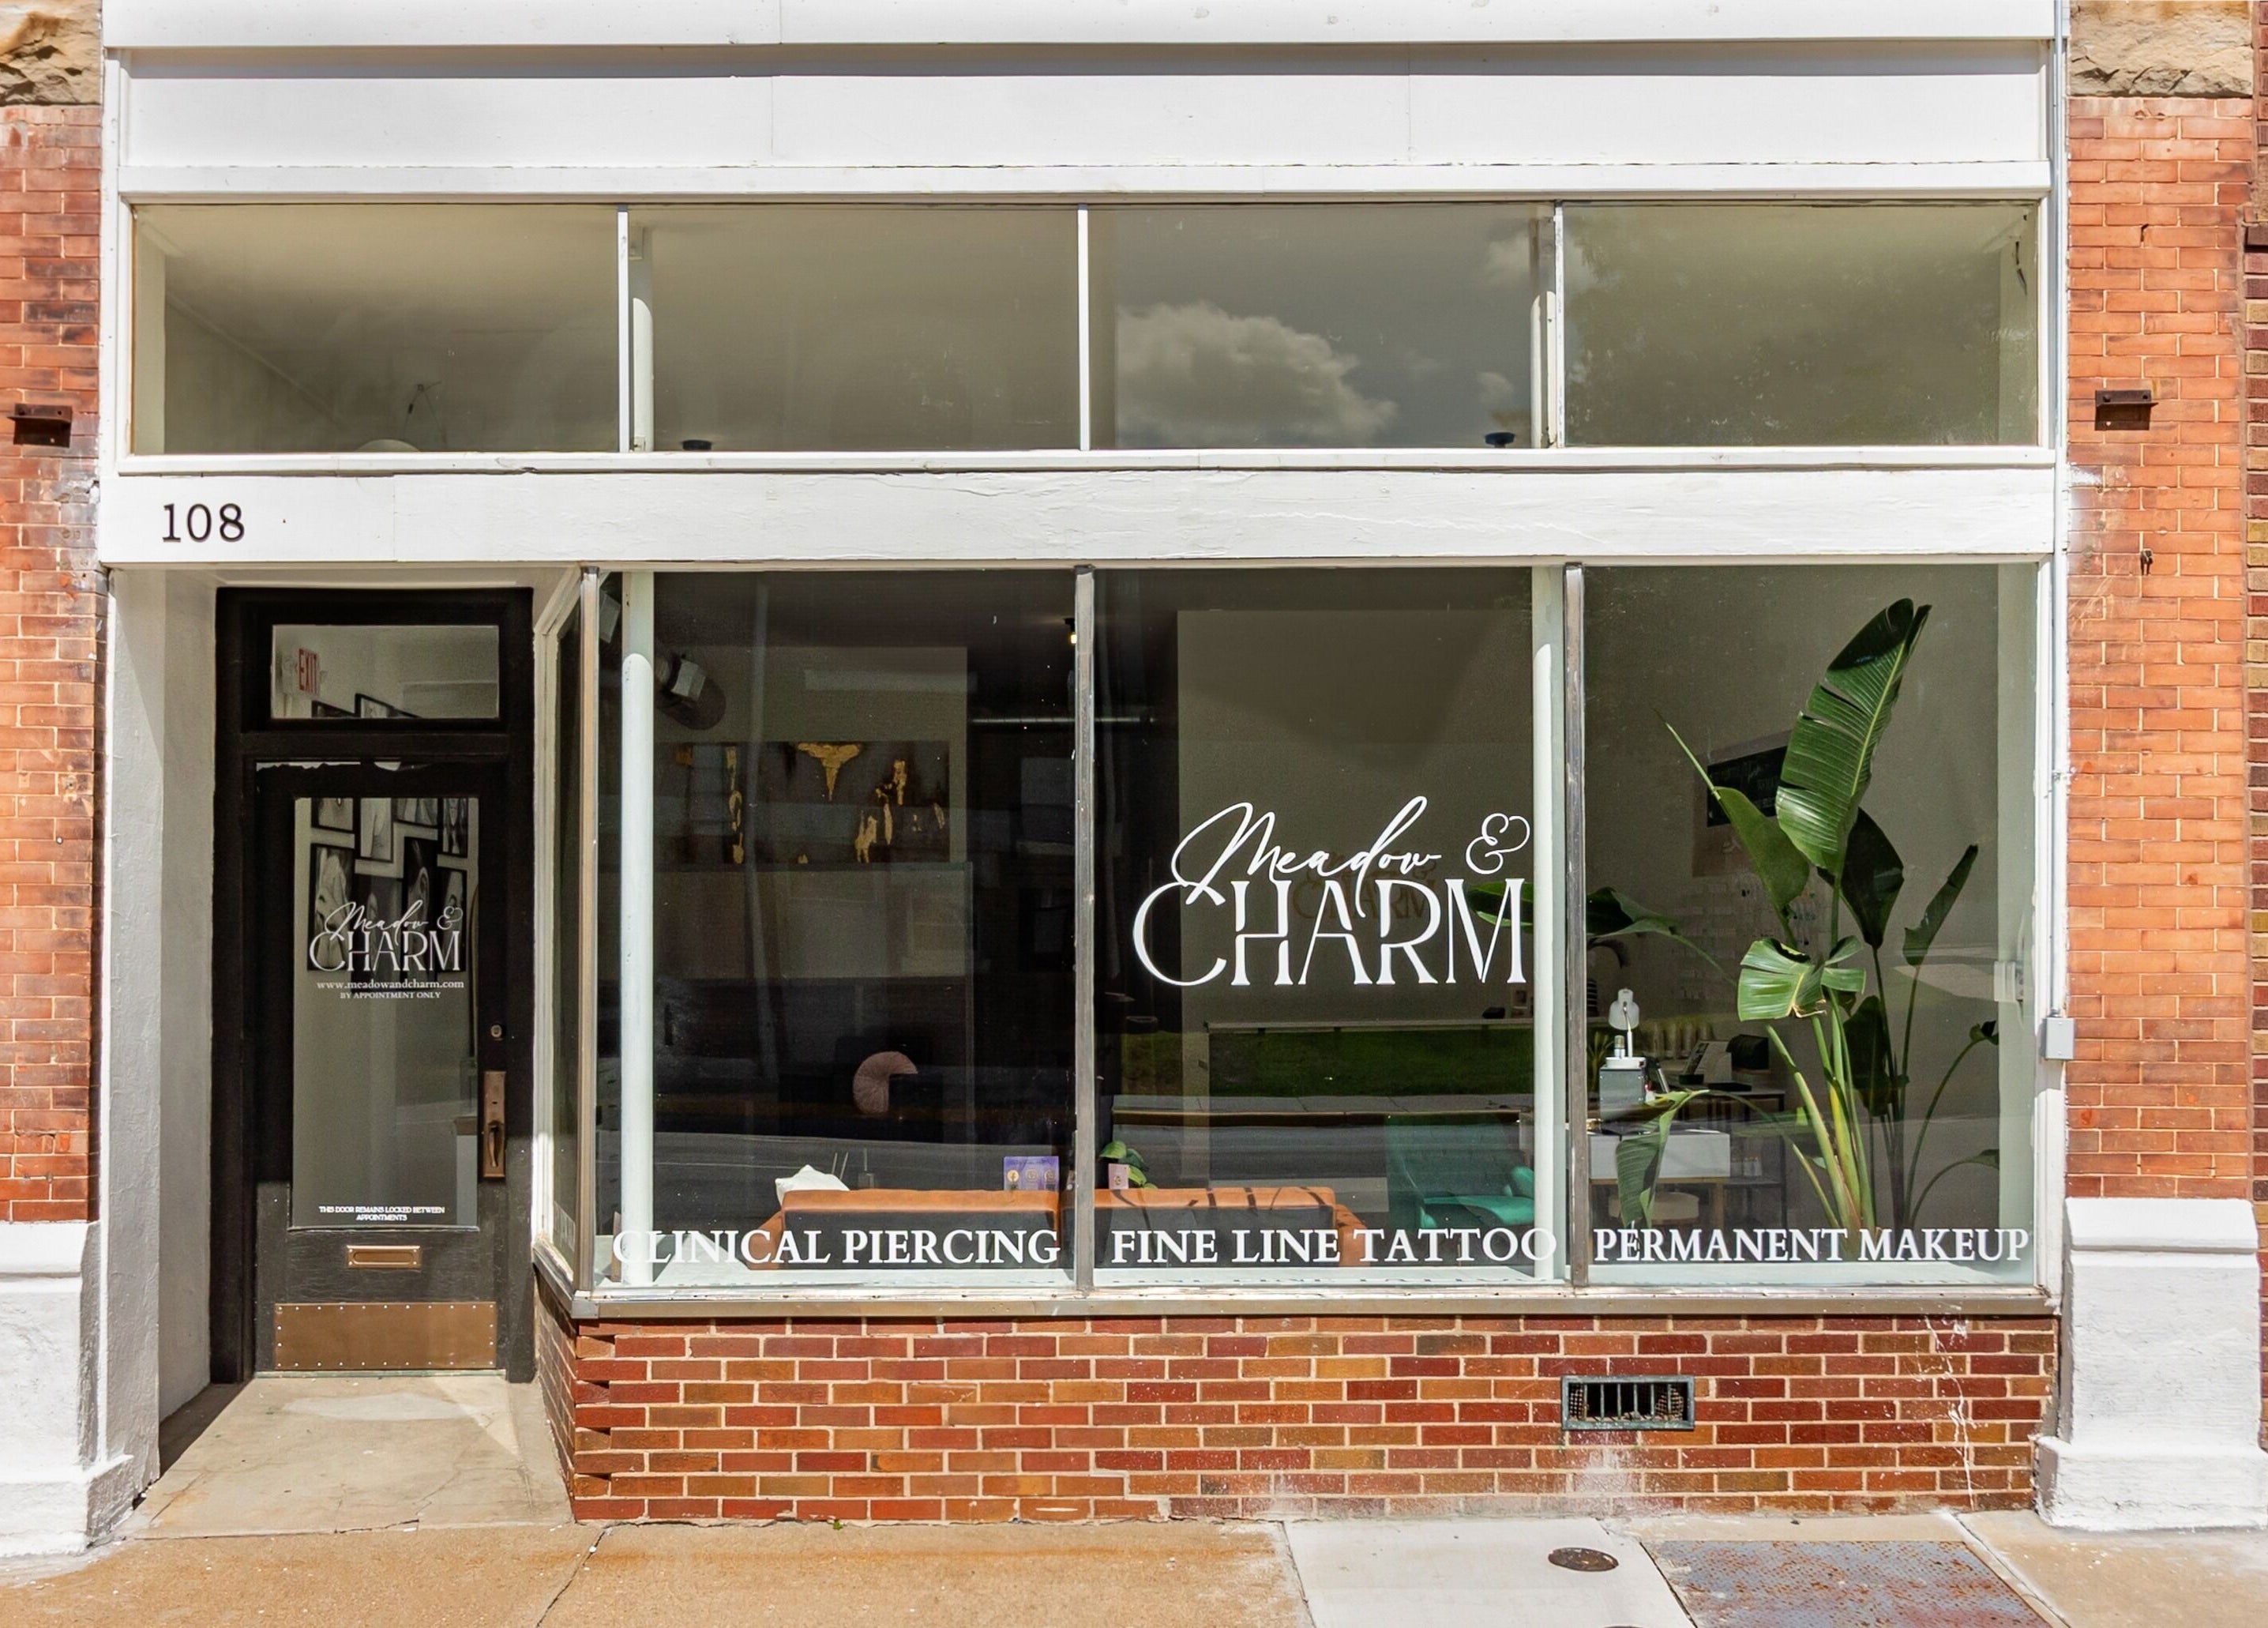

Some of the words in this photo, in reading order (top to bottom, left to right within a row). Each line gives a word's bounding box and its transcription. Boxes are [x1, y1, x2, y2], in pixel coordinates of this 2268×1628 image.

[162, 503, 246, 543] 108
[299, 648, 319, 694] EXIT
[1171, 795, 1441, 918] Meadow
[1466, 813, 1530, 874] &
[325, 900, 428, 946] Meadow
[437, 906, 464, 930] &
[1132, 878, 1527, 987] CHARM
[310, 931, 460, 971] CHARM
[317, 979, 464, 989] www.meadowandcharm.com
[613, 1230, 831, 1264] CLINICAL
[842, 1230, 1061, 1264] PIERCING
[1111, 1229, 1218, 1263] FINE
[1232, 1229, 1341, 1263] LINE
[1353, 1228, 1557, 1262] TATTOO
[1594, 1228, 1849, 1262] PERMANENT
[1858, 1228, 2030, 1262] MAKEUP
